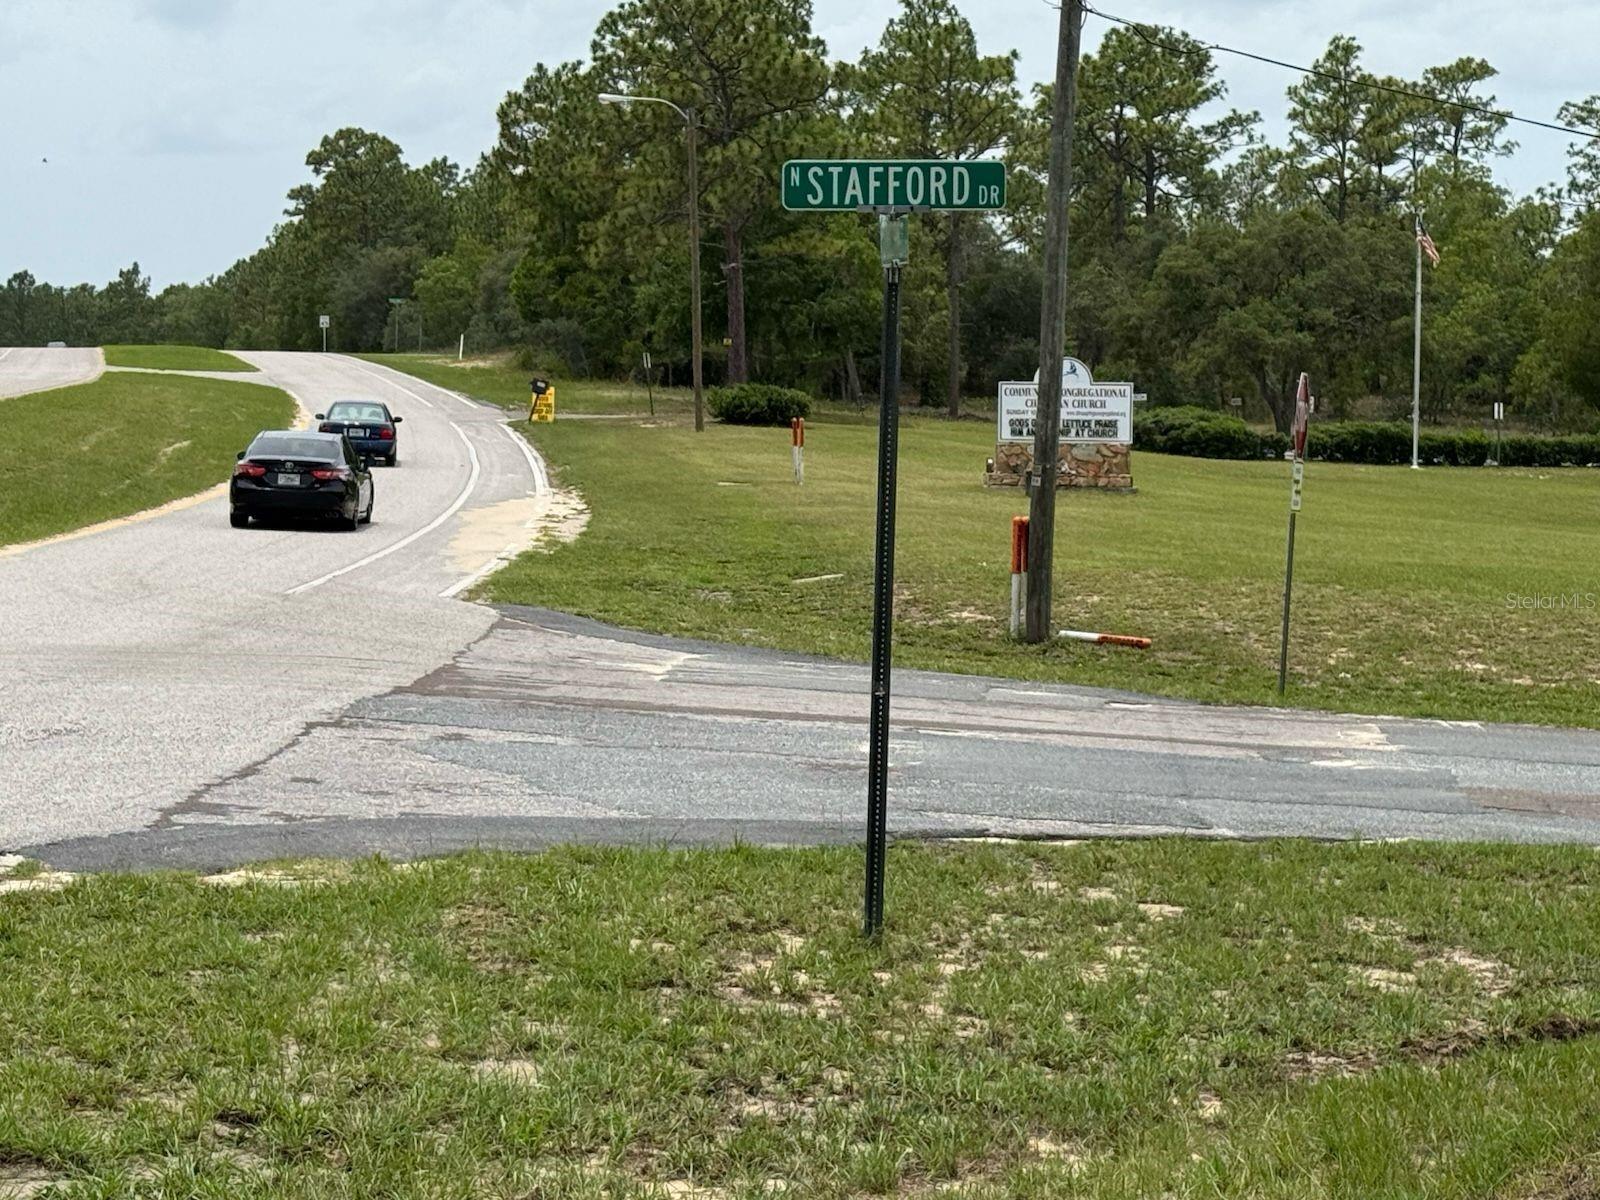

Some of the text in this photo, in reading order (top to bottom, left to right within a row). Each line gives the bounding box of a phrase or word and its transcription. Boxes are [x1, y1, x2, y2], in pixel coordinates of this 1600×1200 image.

[791, 166, 1000, 206] N STAFFORD DR
[1061, 388, 1127, 398] ONGREGATIONAL
[1072, 400, 1106, 409] CHURCH
[1062, 419, 1092, 429] LETTUCE
[1094, 419, 1118, 428] PRAISE
[1075, 428, 1086, 437] AT
[1087, 428, 1118, 438] CHURCH
